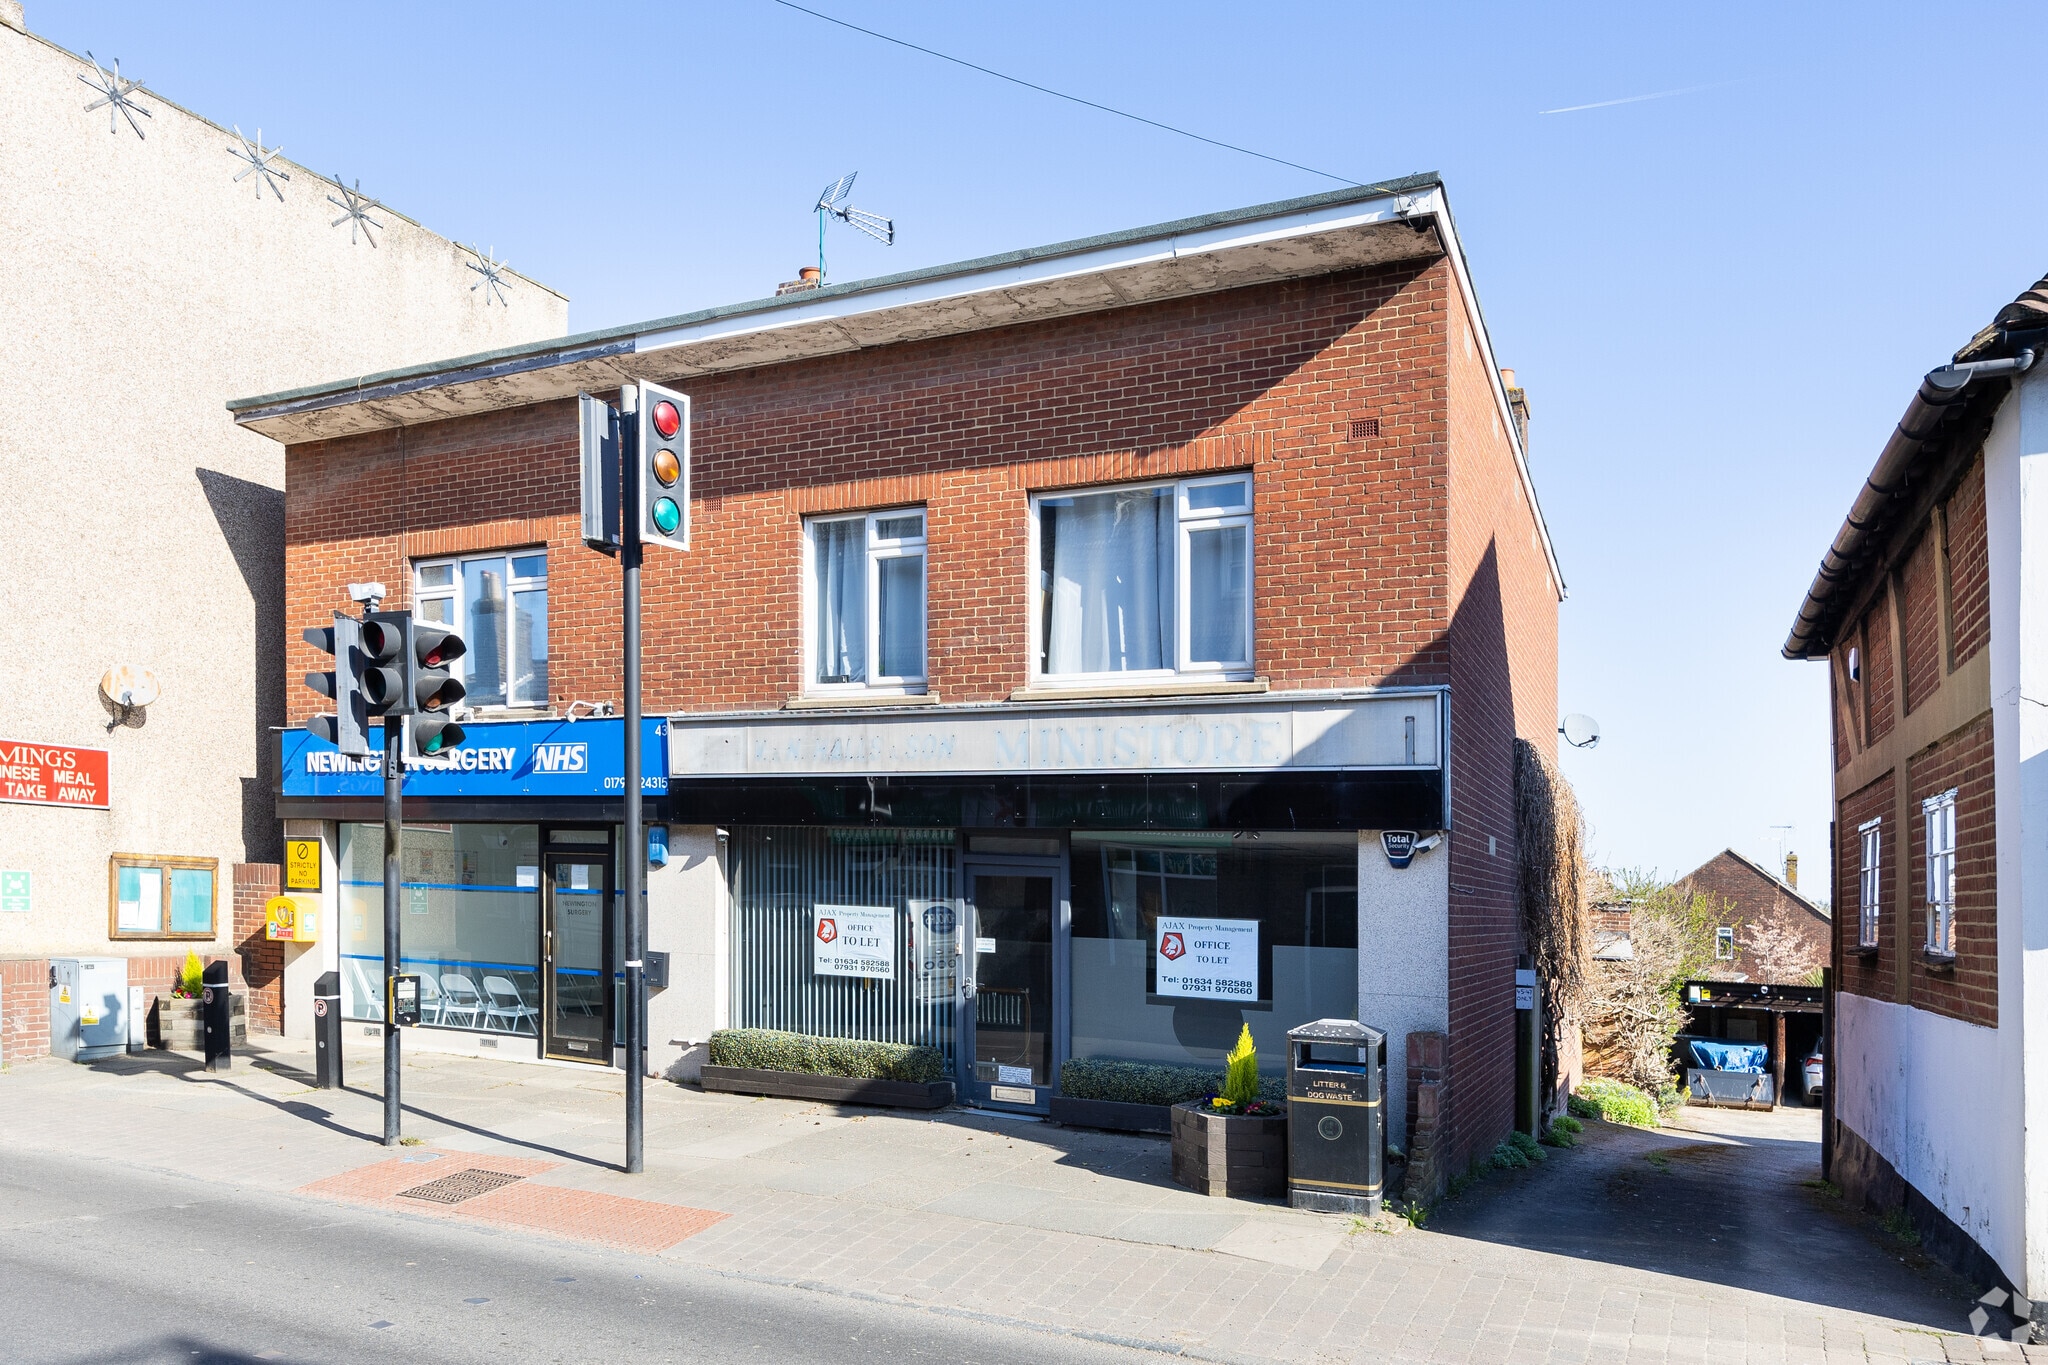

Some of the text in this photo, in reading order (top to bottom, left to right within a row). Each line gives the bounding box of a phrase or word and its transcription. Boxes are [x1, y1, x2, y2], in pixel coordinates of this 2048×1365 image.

[995, 722, 1282, 767] MINISTORE
[534, 745, 585, 771] NHS
[53, 769, 95, 786] MEAL
[5, 782, 97, 802] TAKE AWAY
[1387, 834, 1410, 843] Total
[290, 878, 316, 886] PARKING
[562, 900, 597, 908] NEWINGTON
[567, 908, 592, 916] SURGERY
[819, 909, 837, 917] AJAX
[839, 910, 859, 918] Property
[847, 924, 874, 932] OFFICE
[1162, 922, 1253, 933] AJAX Property Management
[842, 936, 880, 948] TO LET
[1194, 940, 1231, 950] OFFICE
[818, 956, 832, 964] Tel:
[860, 959, 890, 967] 582588
[1196, 956, 1230, 965] TO LET
[860, 966, 890, 974] 970560
[1162, 976, 1253, 988] Tel: 01634 582588
[1182, 984, 1253, 995] 07931 970560
[1313, 1080, 1340, 1088] LITTER
[1307, 1091, 1353, 1101] DOG WASTE
